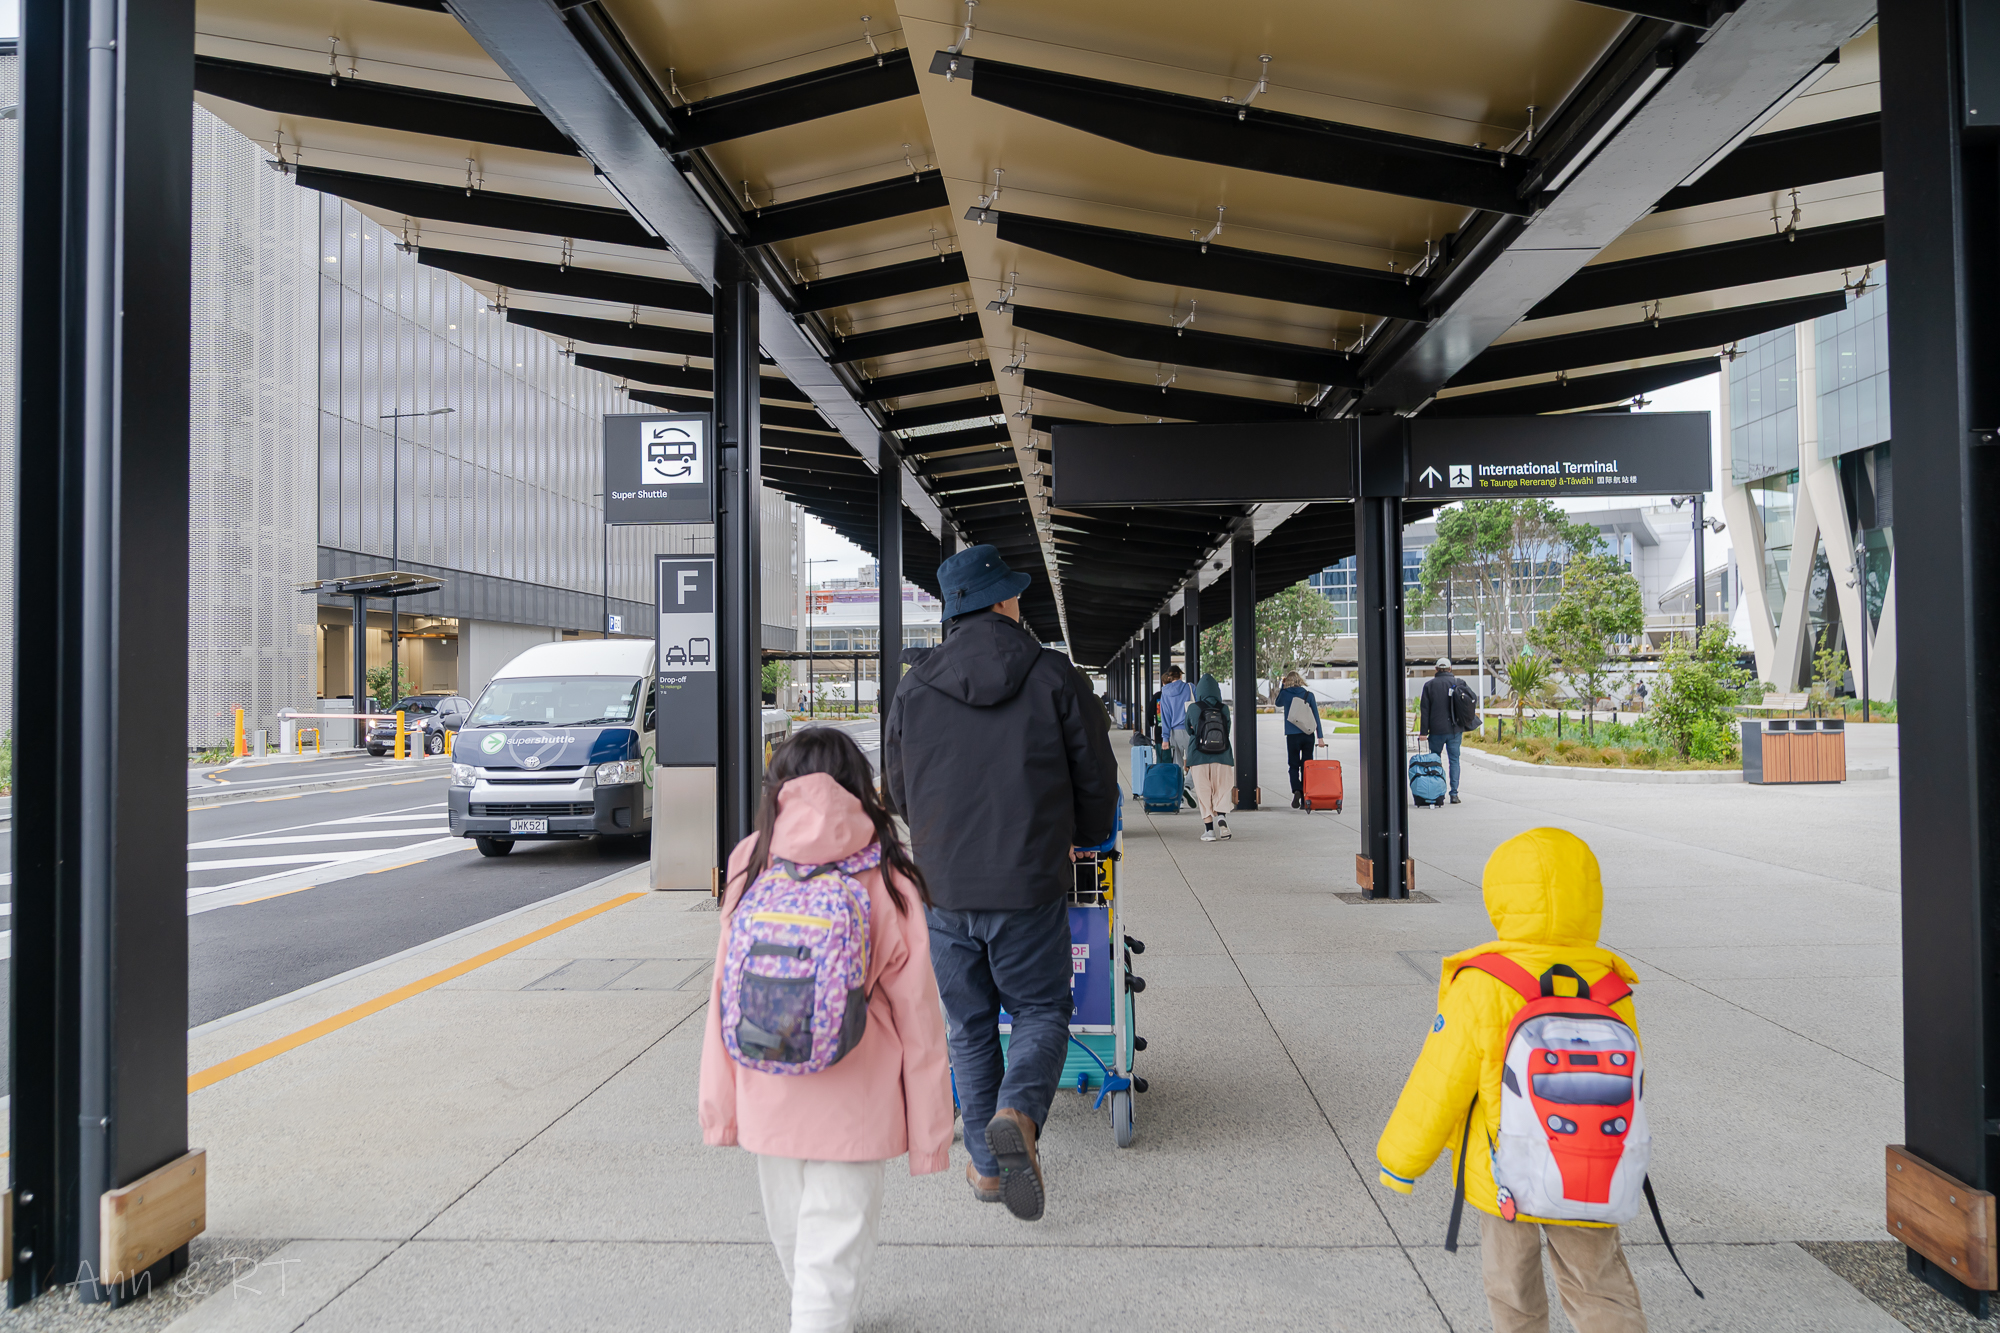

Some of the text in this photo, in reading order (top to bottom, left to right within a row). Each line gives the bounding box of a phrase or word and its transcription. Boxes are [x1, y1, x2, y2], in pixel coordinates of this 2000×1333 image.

[1478, 460, 1619, 476] International Terminal
[1479, 479, 1489, 488] Te
[1490, 479, 1518, 489] Taunga
[1519, 478, 1558, 488] Rererangi
[611, 489, 668, 501] Super Shuttle
[677, 570, 699, 605] F
[659, 676, 687, 685] Drop-off
[506, 734, 576, 747] supershuttle
[511, 821, 546, 831] JWK521
